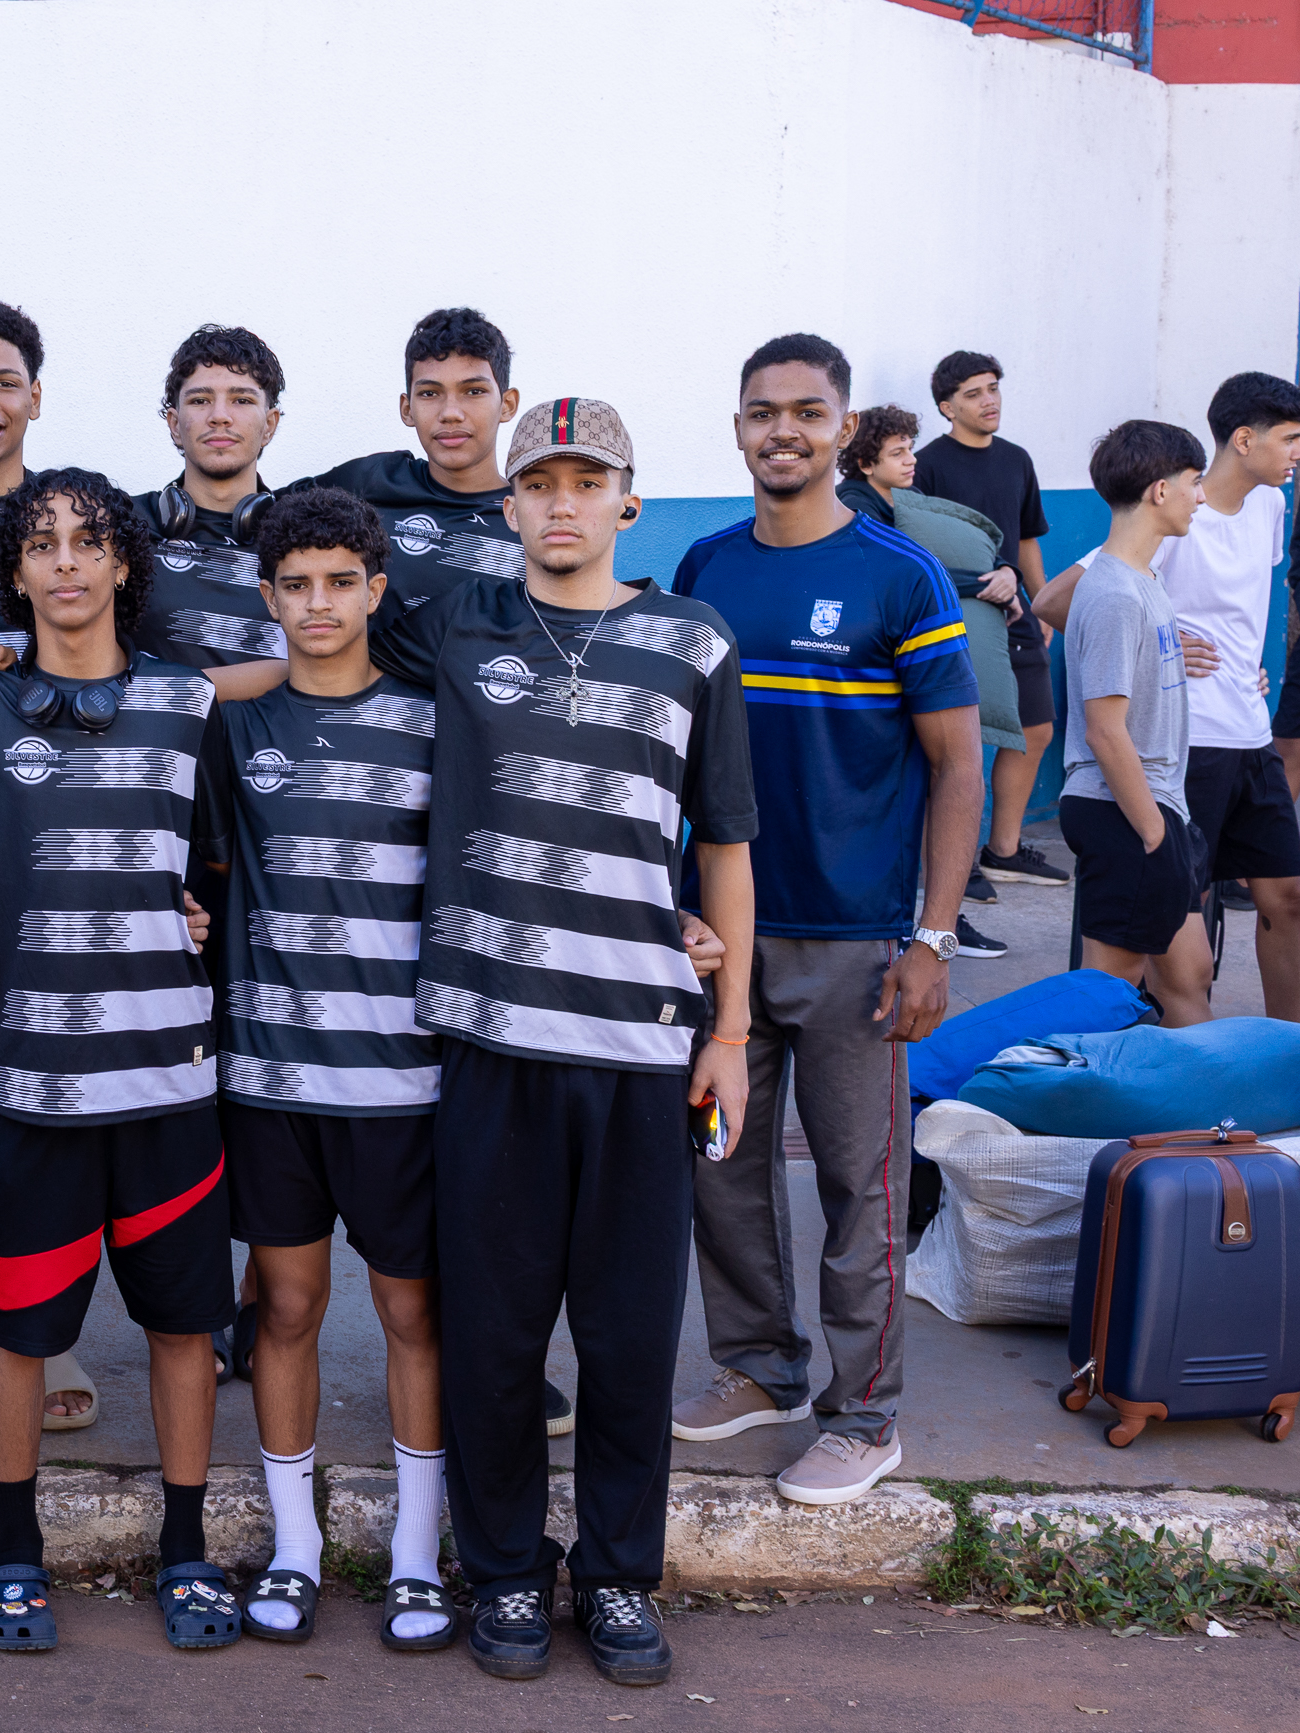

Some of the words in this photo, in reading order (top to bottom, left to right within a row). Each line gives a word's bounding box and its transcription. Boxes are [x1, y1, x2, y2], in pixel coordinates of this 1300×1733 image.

[394, 523, 442, 539] SILVESTRE
[791, 640, 850, 652] RONDONÓPOLIS
[478, 667, 535, 685] SILVESTRE
[23, 687, 43, 705] JBL
[89, 690, 108, 712] JBL
[5, 752, 59, 760] SILVESTRE
[246, 762, 292, 772] SILVESTRE
